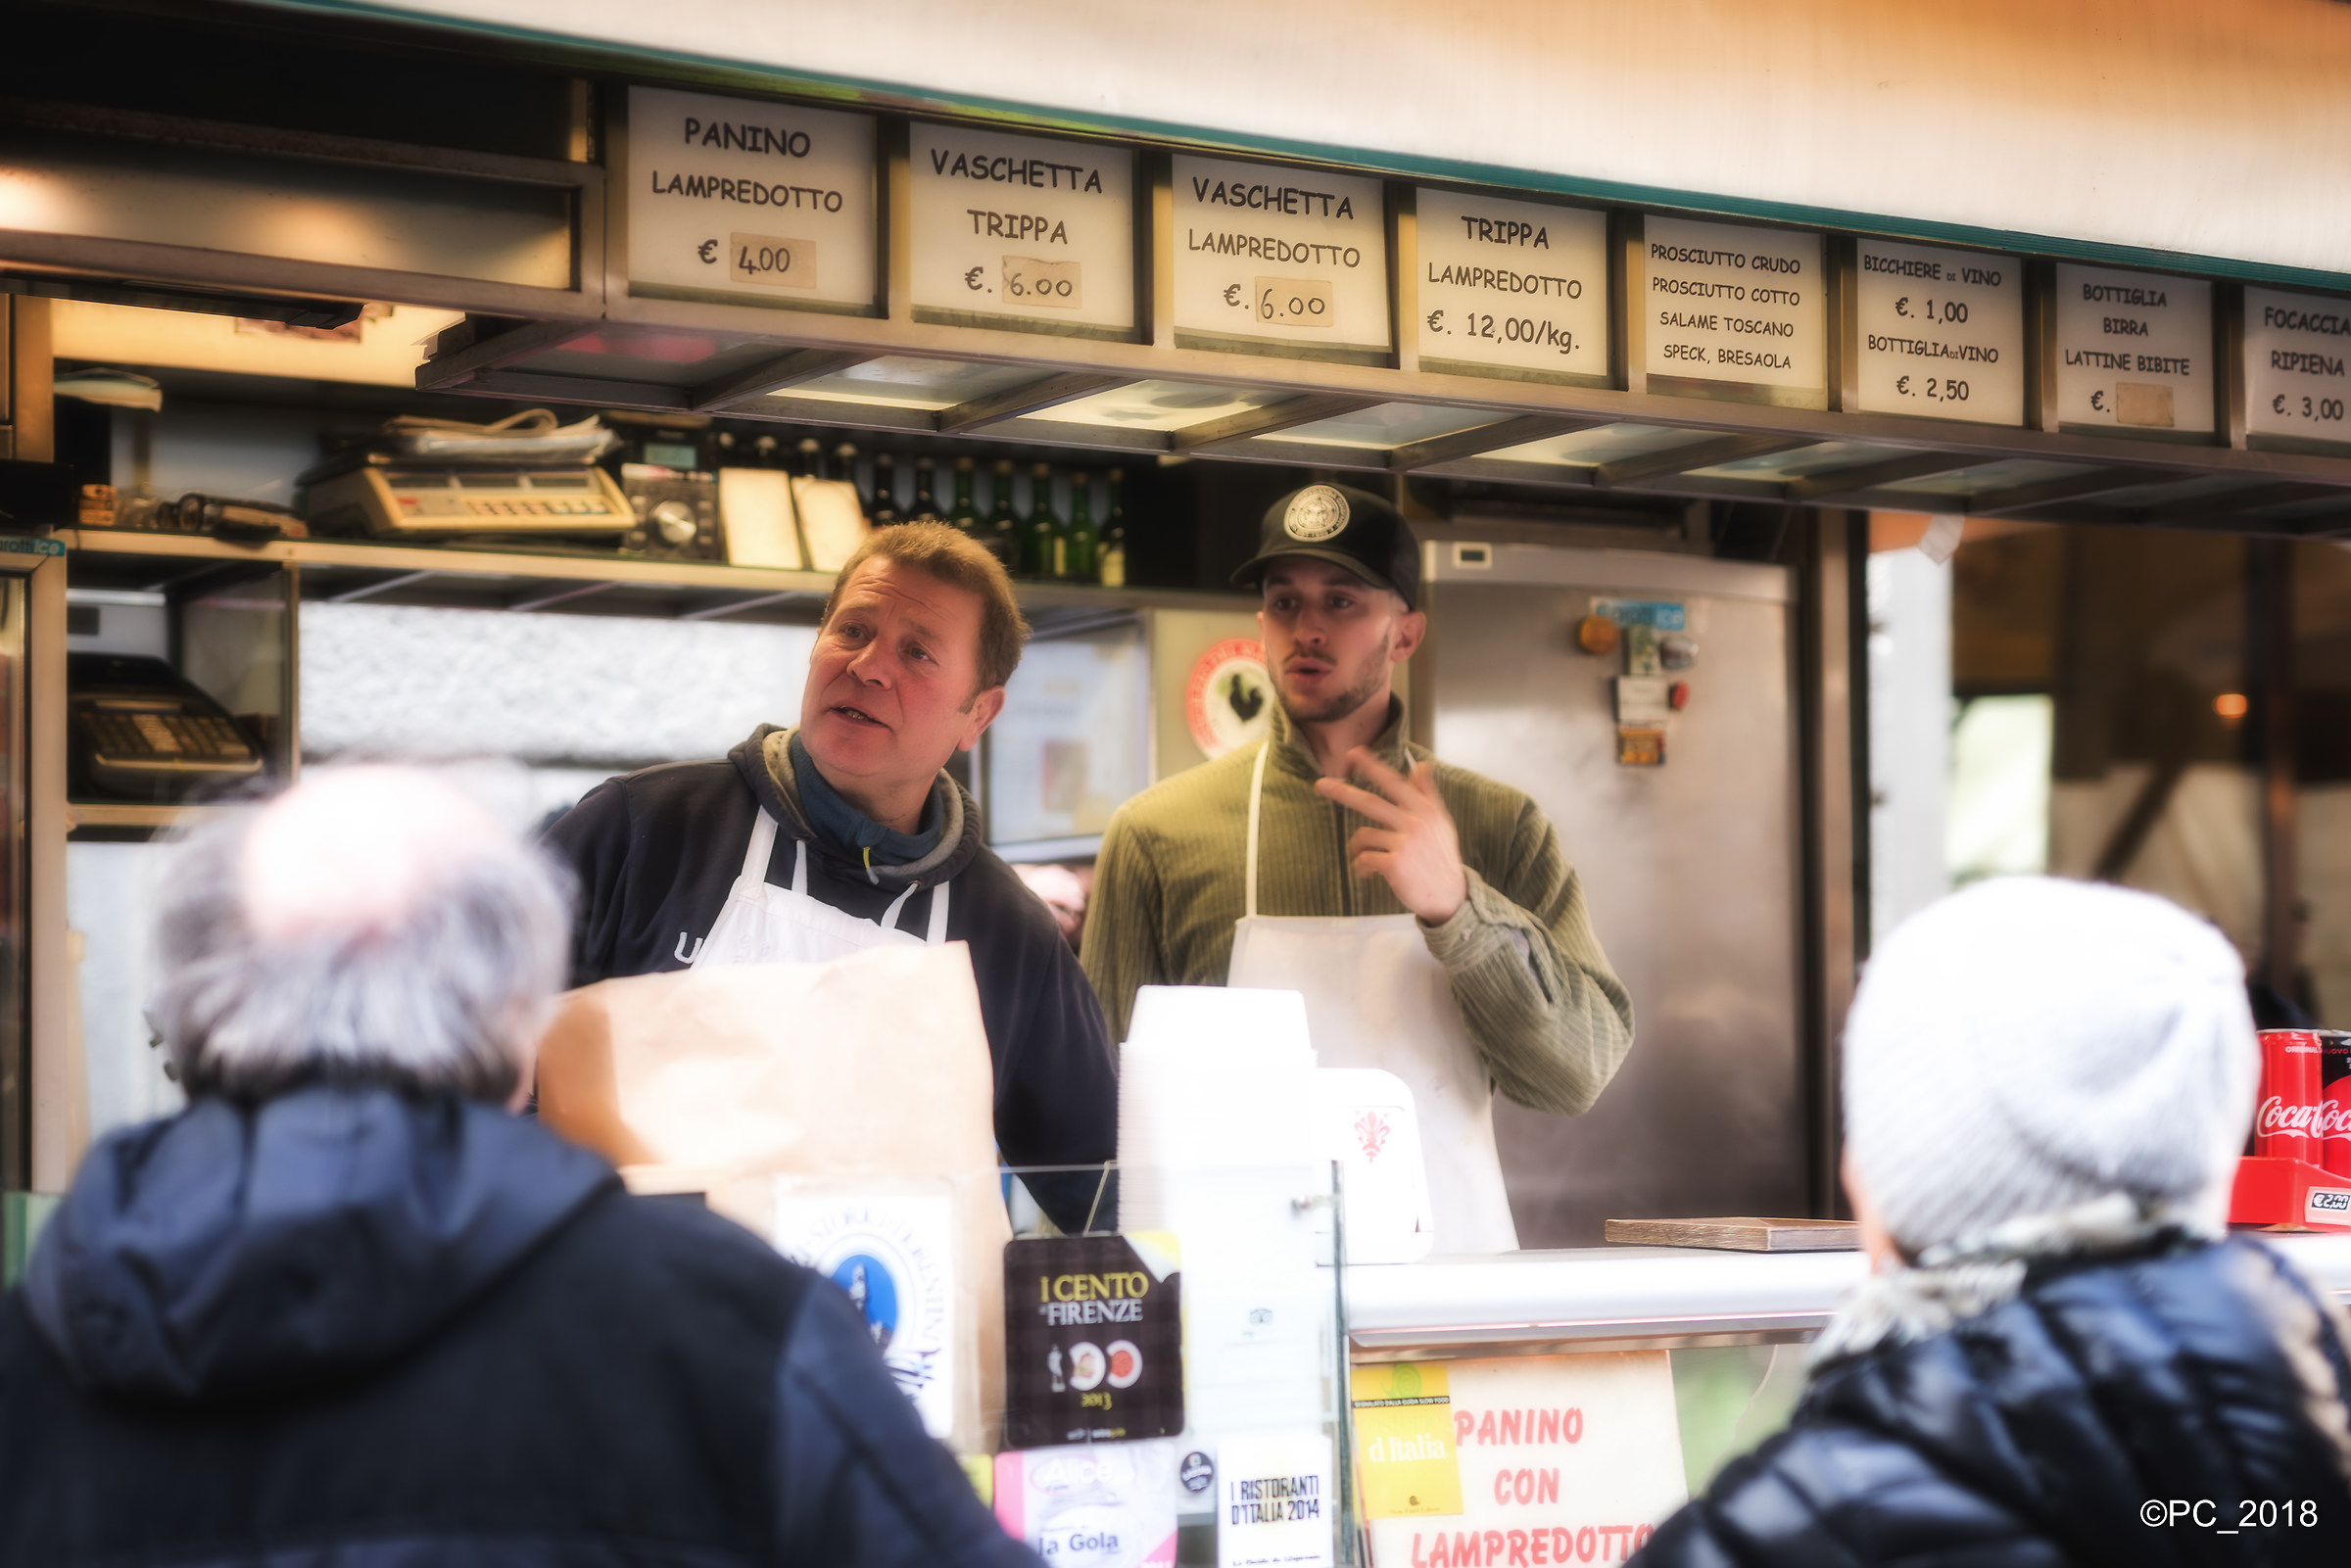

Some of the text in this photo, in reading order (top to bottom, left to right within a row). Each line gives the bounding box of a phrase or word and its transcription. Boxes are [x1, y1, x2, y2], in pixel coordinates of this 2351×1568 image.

[685, 117, 811, 158] PANINO
[930, 146, 1106, 194] VASCHETTA
[651, 169, 843, 213] LAMPREDOTTO
[1192, 173, 1357, 220] VASCHETTA
[966, 209, 1068, 245] TRIPPA
[1461, 214, 1550, 250] TRIPPA
[697, 239, 719, 264] €
[1188, 228, 1361, 268] LAMPREDOTTO
[1651, 243, 1800, 274] PROSCIUTTO CRUDO
[964, 265, 1073, 298] €. 6.00
[1428, 261, 1582, 300] LAMPREDOTTO
[1863, 254, 1942, 281] BICCHIERE
[1961, 267, 2002, 287] VINO
[1223, 283, 1325, 320] €. 6.00
[1653, 276, 1800, 307] PROSCIUTTO COTTO
[2083, 283, 2167, 307] BOTTIGLIA
[1659, 310, 1794, 338] SALAME TOSCANO
[1895, 296, 1969, 325] €. 1,00
[2265, 306, 2351, 336] FOCACCIA
[1426, 309, 1580, 355] €. 12,00/kg.
[2103, 316, 2149, 337] BIRRA
[1663, 344, 1792, 369] SPECK, BRESAOLA
[1868, 334, 1950, 358] BOTTIGLIA
[2065, 349, 2190, 376] LATTINE BIBITE
[2271, 350, 2345, 377] RIPIENA
[1895, 375, 1970, 403] €. 2,50
[2090, 390, 2111, 413] €.
[2272, 394, 2344, 422] €. 3,00
[1040, 1271, 1149, 1303] I CENTO
[1049, 1300, 1143, 1325] FIRENZE
[1454, 1406, 1585, 1448] PANINO
[1229, 1481, 1235, 1502] I
[1239, 1475, 1320, 1500] RISTORANTI
[1494, 1467, 1560, 1506] CON
[1287, 1498, 1319, 1521] 2014
[1069, 1532, 1120, 1552] Gola
